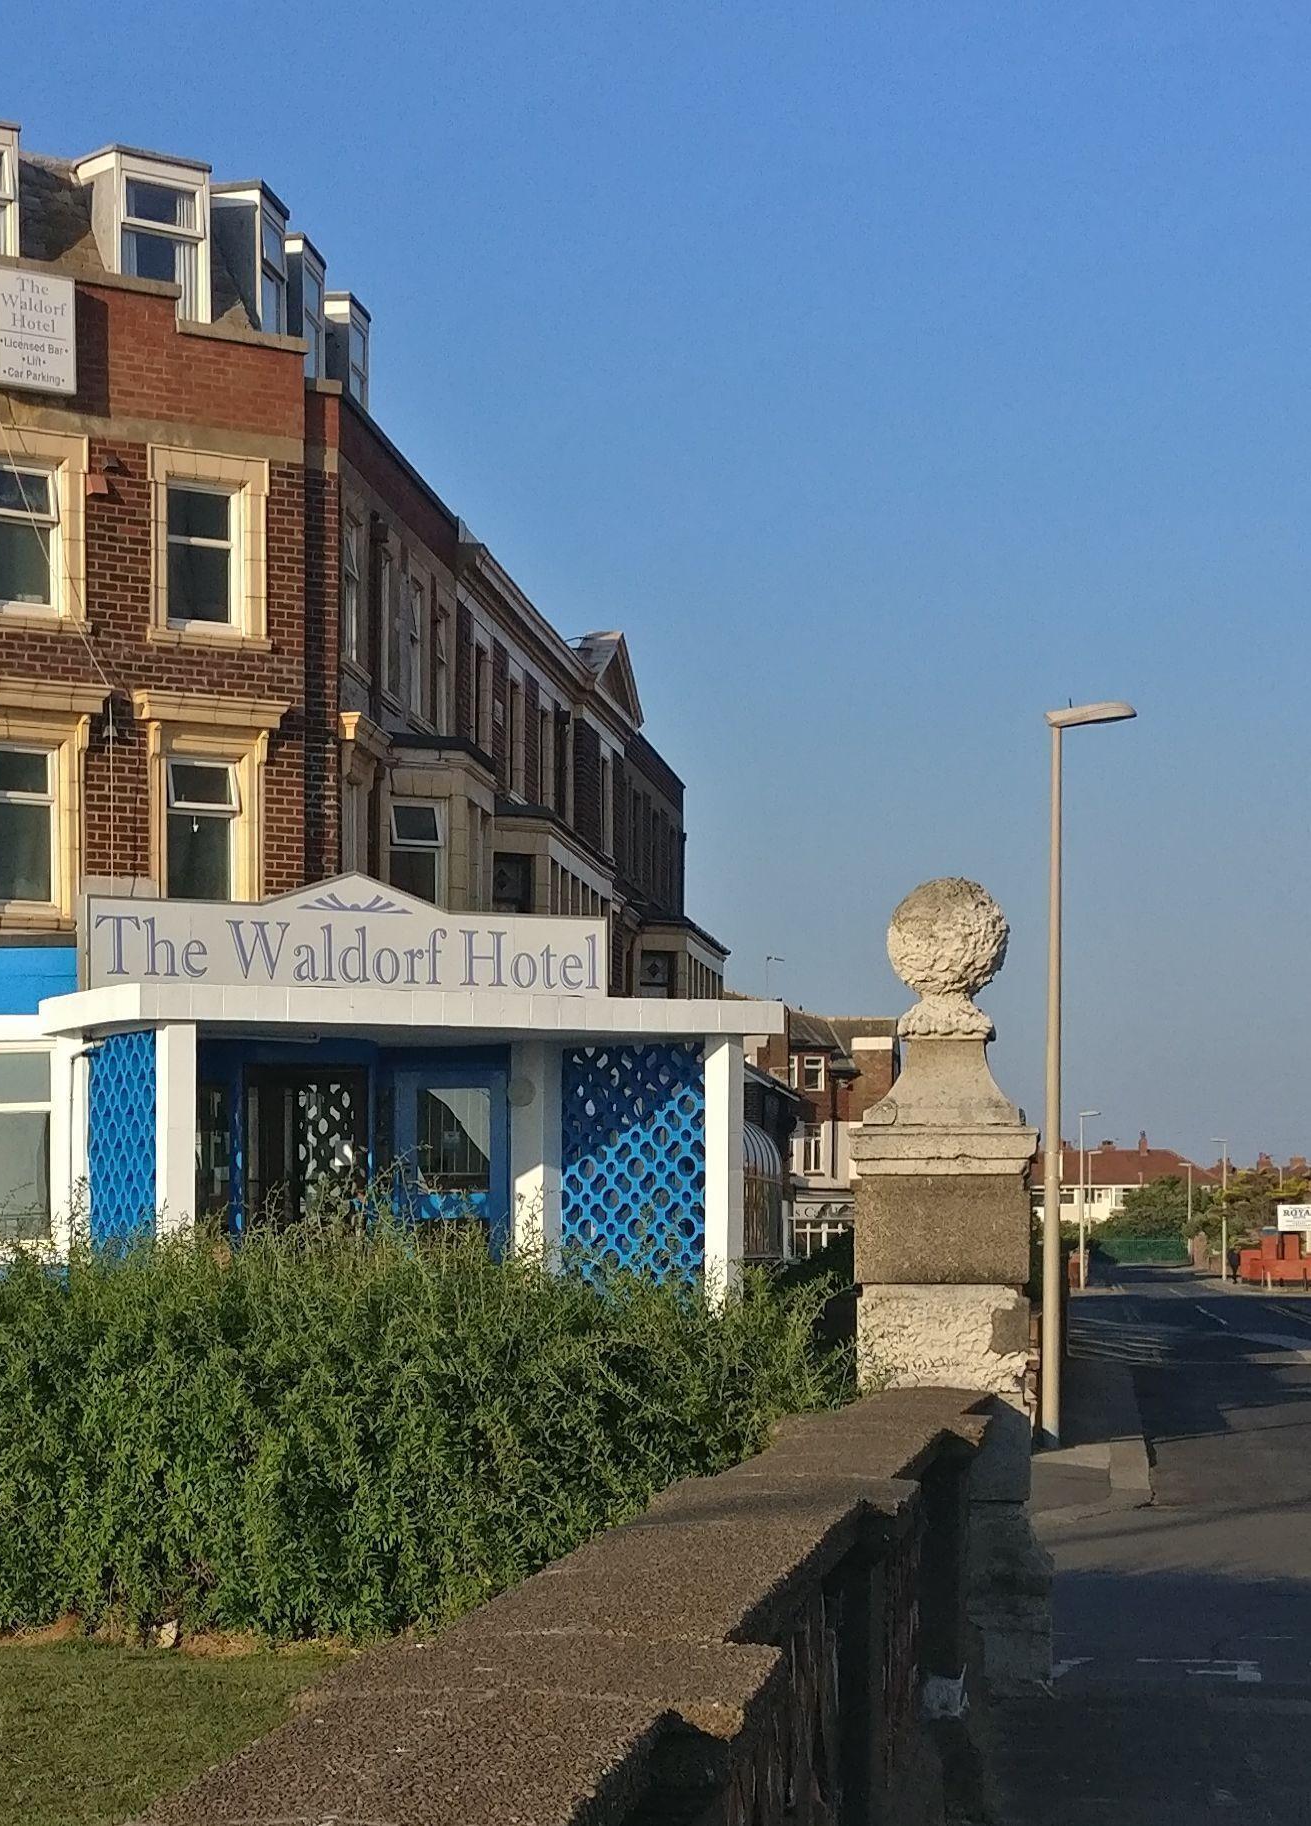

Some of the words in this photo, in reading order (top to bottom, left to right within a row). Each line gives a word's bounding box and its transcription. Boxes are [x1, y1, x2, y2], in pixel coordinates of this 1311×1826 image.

[17, 277, 49, 296] The
[1, 293, 67, 316] Waldorf
[11, 313, 56, 333] Hotel
[48, 344, 63, 356] Bar
[8, 368, 23, 379] Car
[26, 371, 61, 387] Parking
[95, 914, 209, 978] The
[226, 919, 448, 985] Waldorf
[459, 929, 601, 991] Hotel
